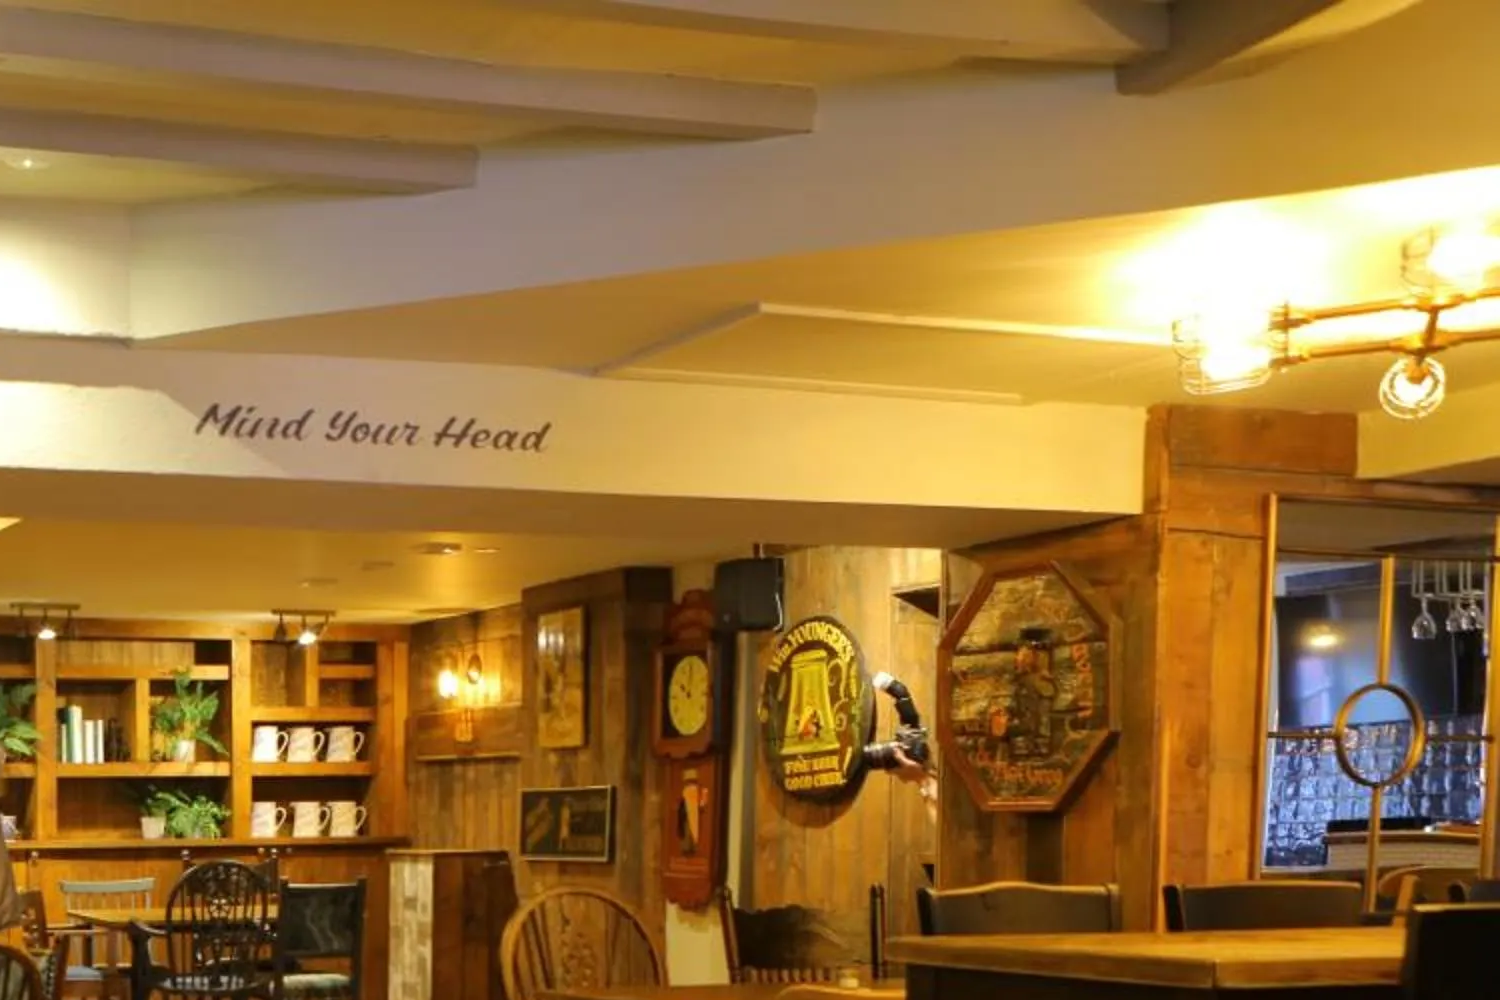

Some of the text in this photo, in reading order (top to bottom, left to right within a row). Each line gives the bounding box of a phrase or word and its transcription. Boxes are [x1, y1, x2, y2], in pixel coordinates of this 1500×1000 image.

[195, 402, 552, 453] Mind Your Head
